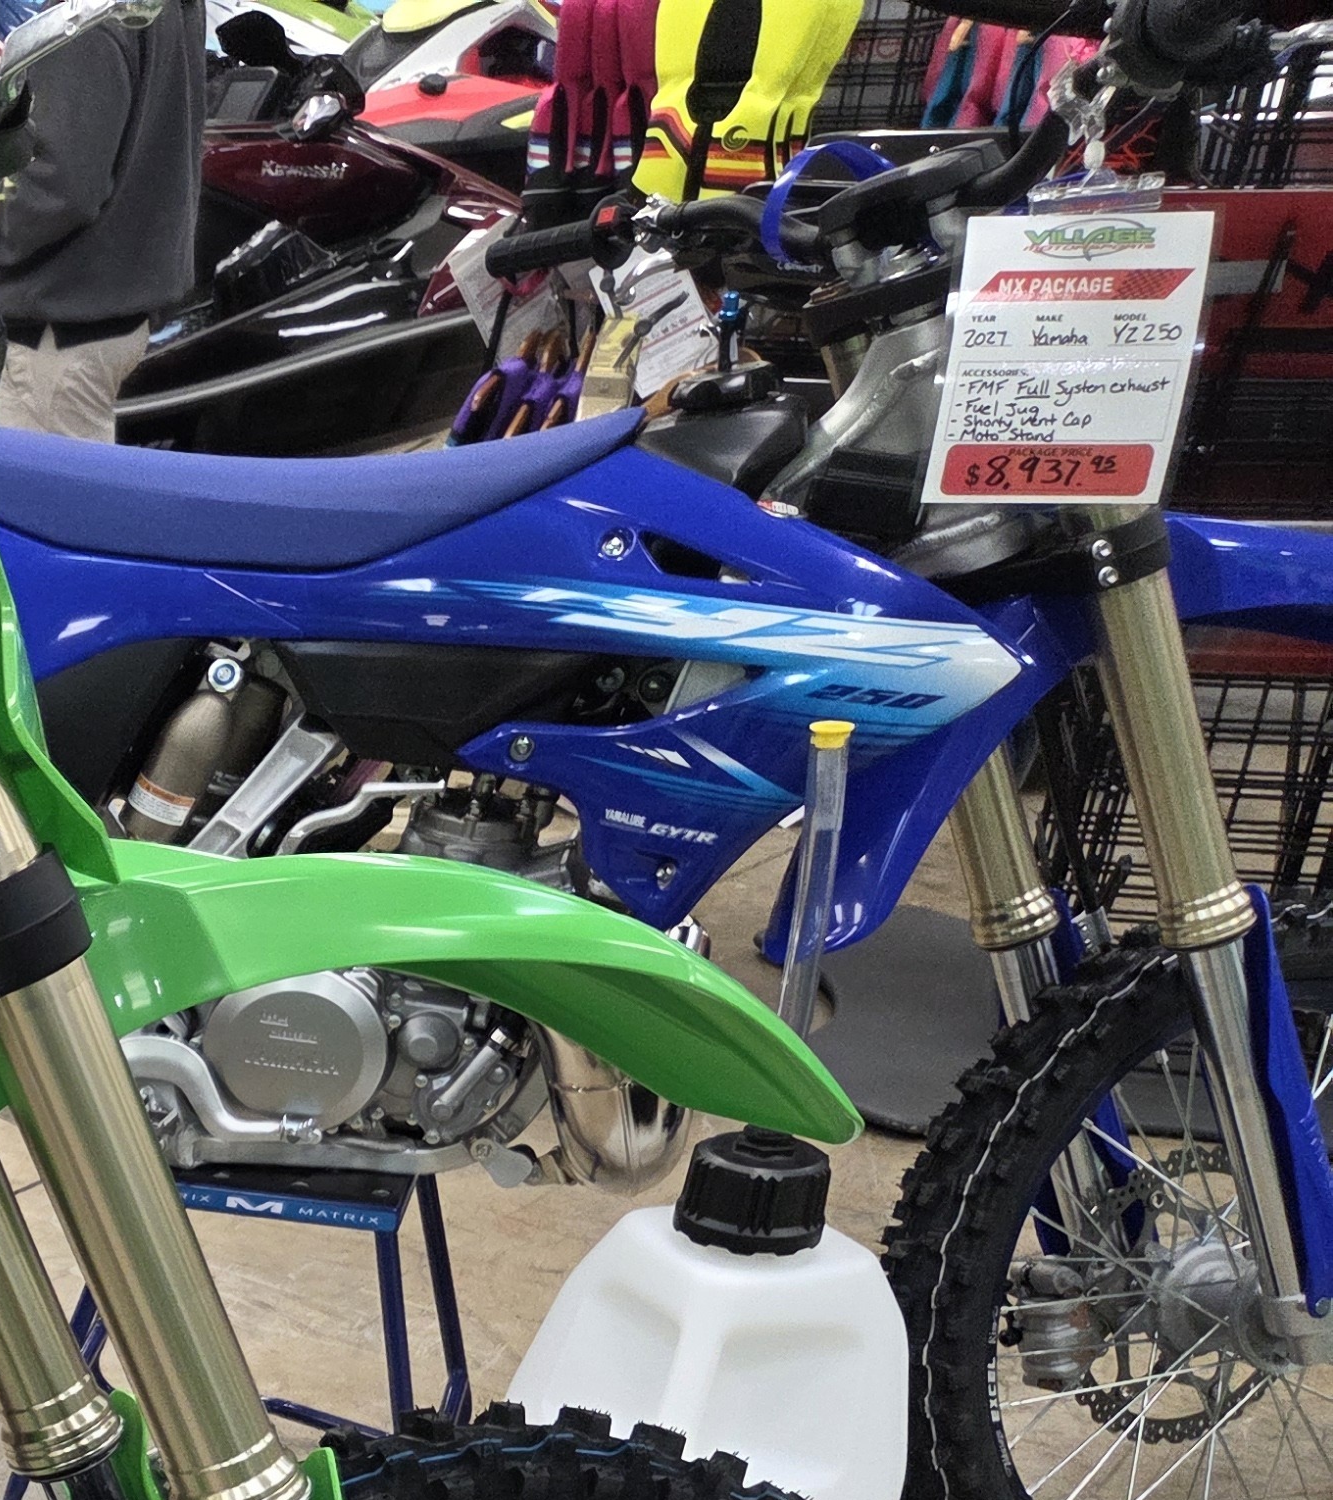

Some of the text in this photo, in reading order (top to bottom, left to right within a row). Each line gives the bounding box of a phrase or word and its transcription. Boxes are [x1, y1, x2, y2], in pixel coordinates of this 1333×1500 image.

[1024, 226, 1156, 244] VILLAGE
[998, 276, 1114, 296] MX PACKAGE
[971, 313, 1148, 323] YEAR MAKE MODEL
[963, 329, 1007, 348] 2027
[1032, 327, 1088, 347] Yamaha
[1143, 323, 1183, 342] 250
[967, 380, 1013, 396] FMF
[1015, 379, 1050, 398] Full
[965, 401, 999, 417] Fuel
[1008, 427, 1055, 442] Stand
[805, 684, 945, 709] 250
[645, 823, 720, 846] GYTR
[298, 1206, 380, 1225] MATRIX
